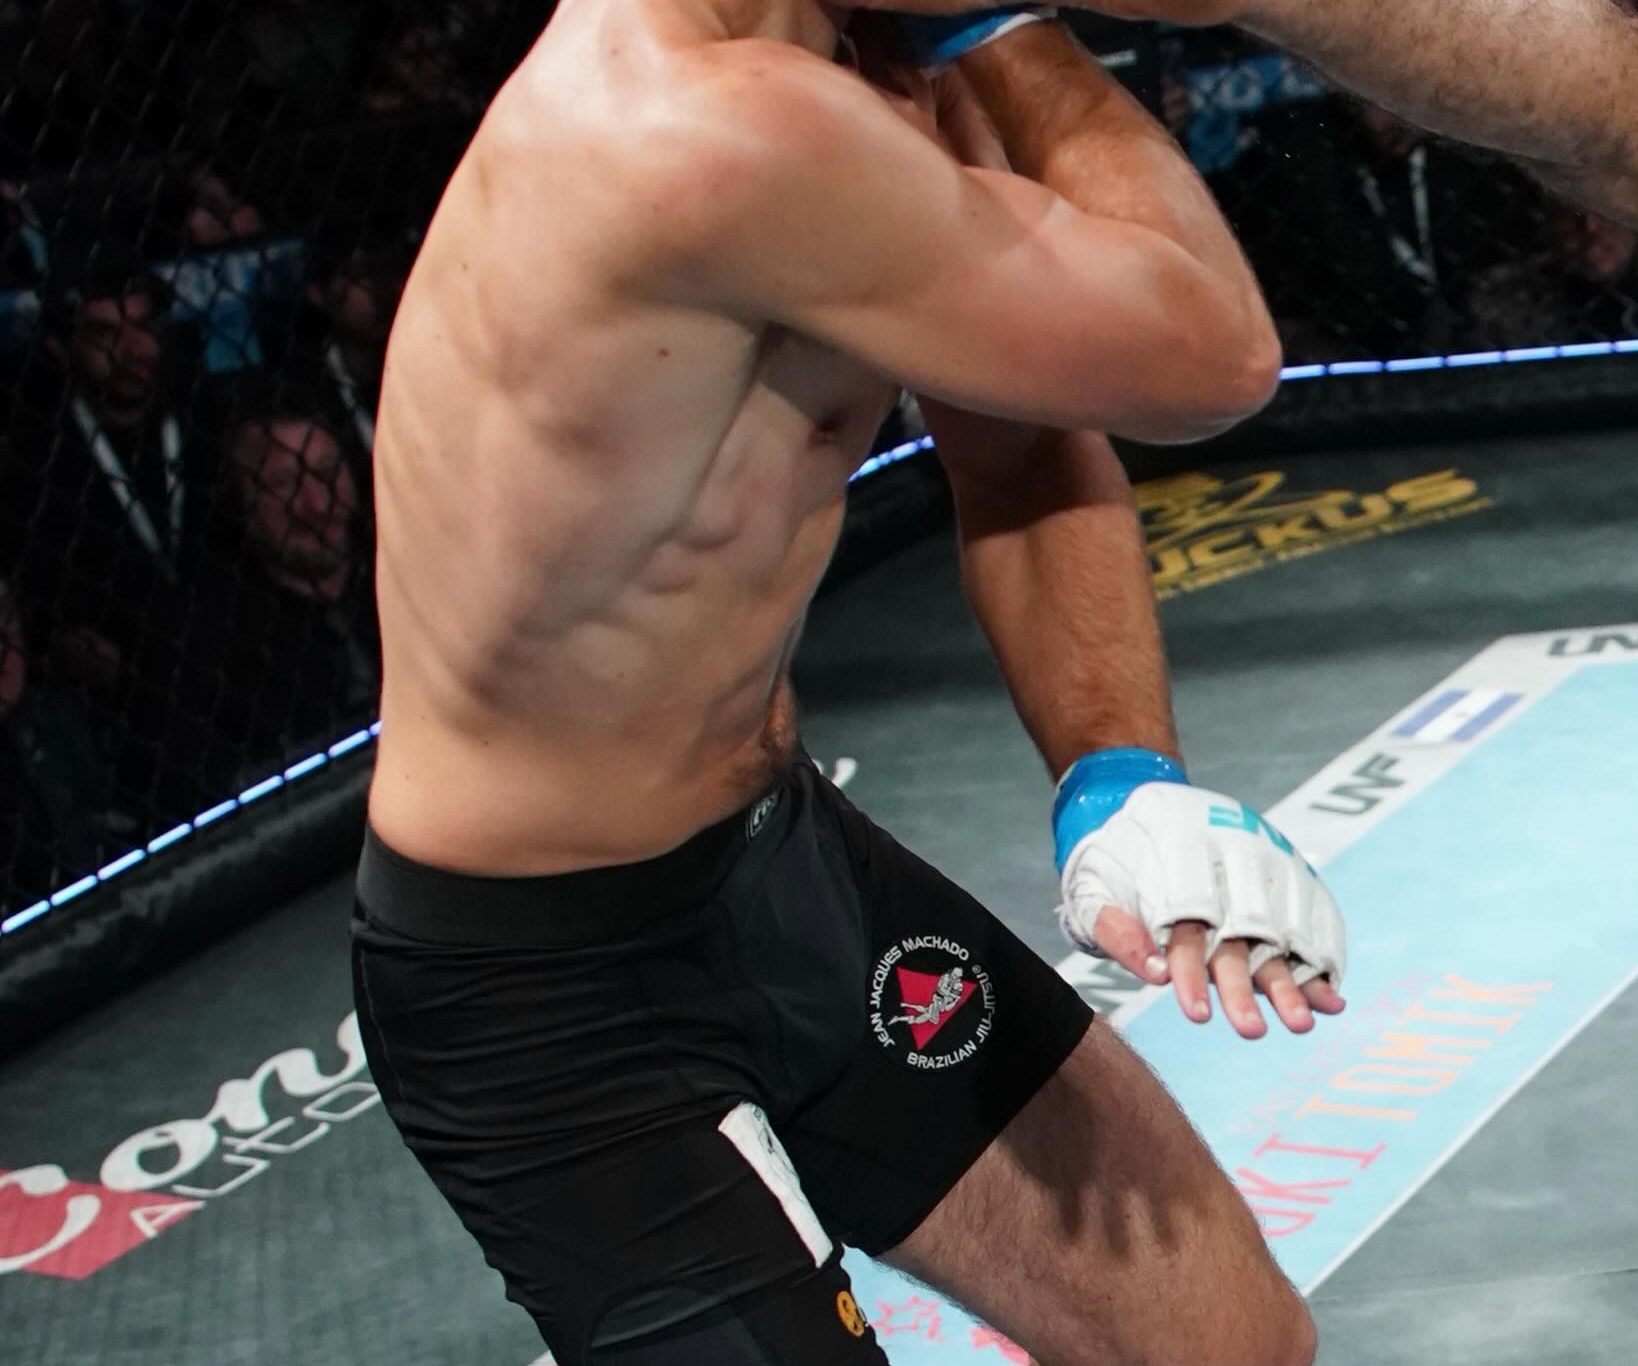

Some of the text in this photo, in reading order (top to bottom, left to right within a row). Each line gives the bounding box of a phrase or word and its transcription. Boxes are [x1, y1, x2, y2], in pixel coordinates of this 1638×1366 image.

[869, 935, 970, 1048] JEAN JACQUES MACHADO
[906, 1039, 978, 1069] BRAZILIAN
